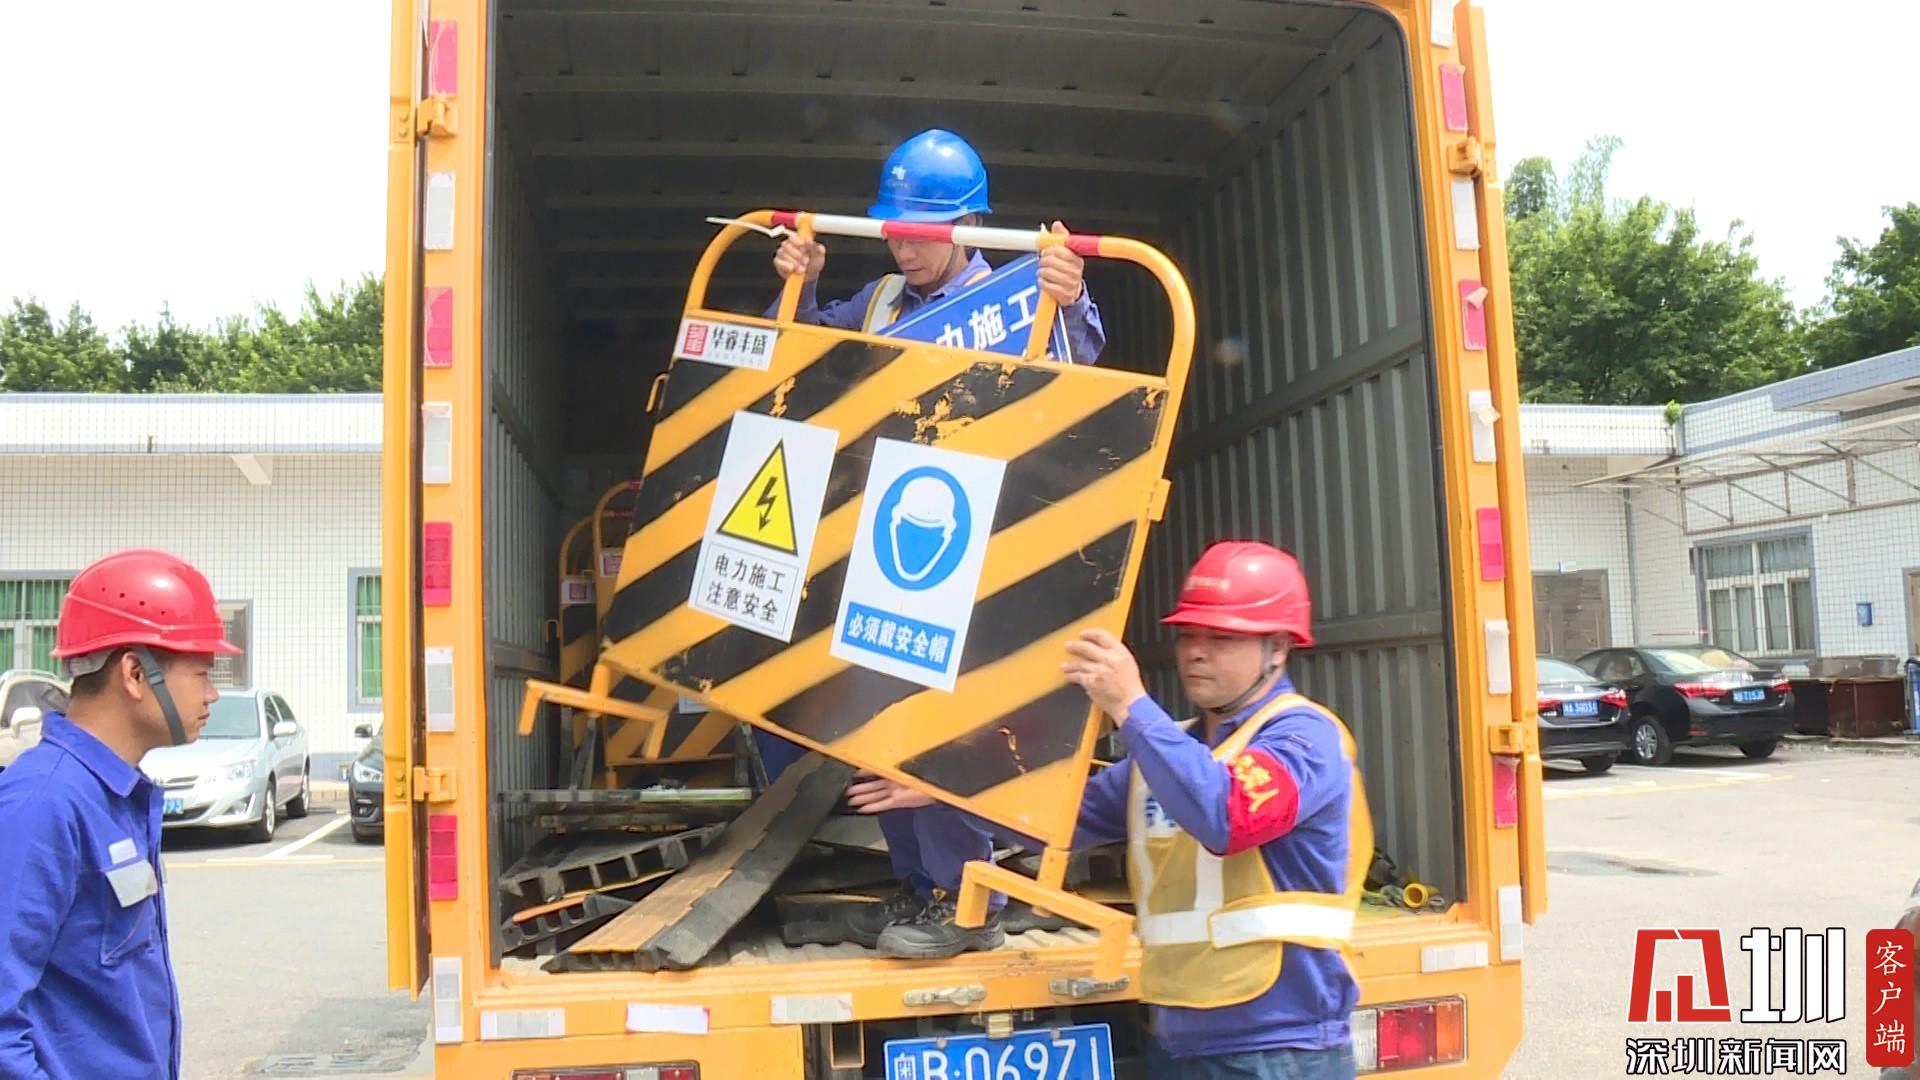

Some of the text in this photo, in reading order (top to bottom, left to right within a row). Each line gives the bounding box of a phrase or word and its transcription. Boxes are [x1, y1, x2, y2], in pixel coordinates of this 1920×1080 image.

[714, 552, 786, 593] 电力施工
[706, 580, 779, 624] 注意安全
[847, 612, 950, 665] 必须戴安全帽
